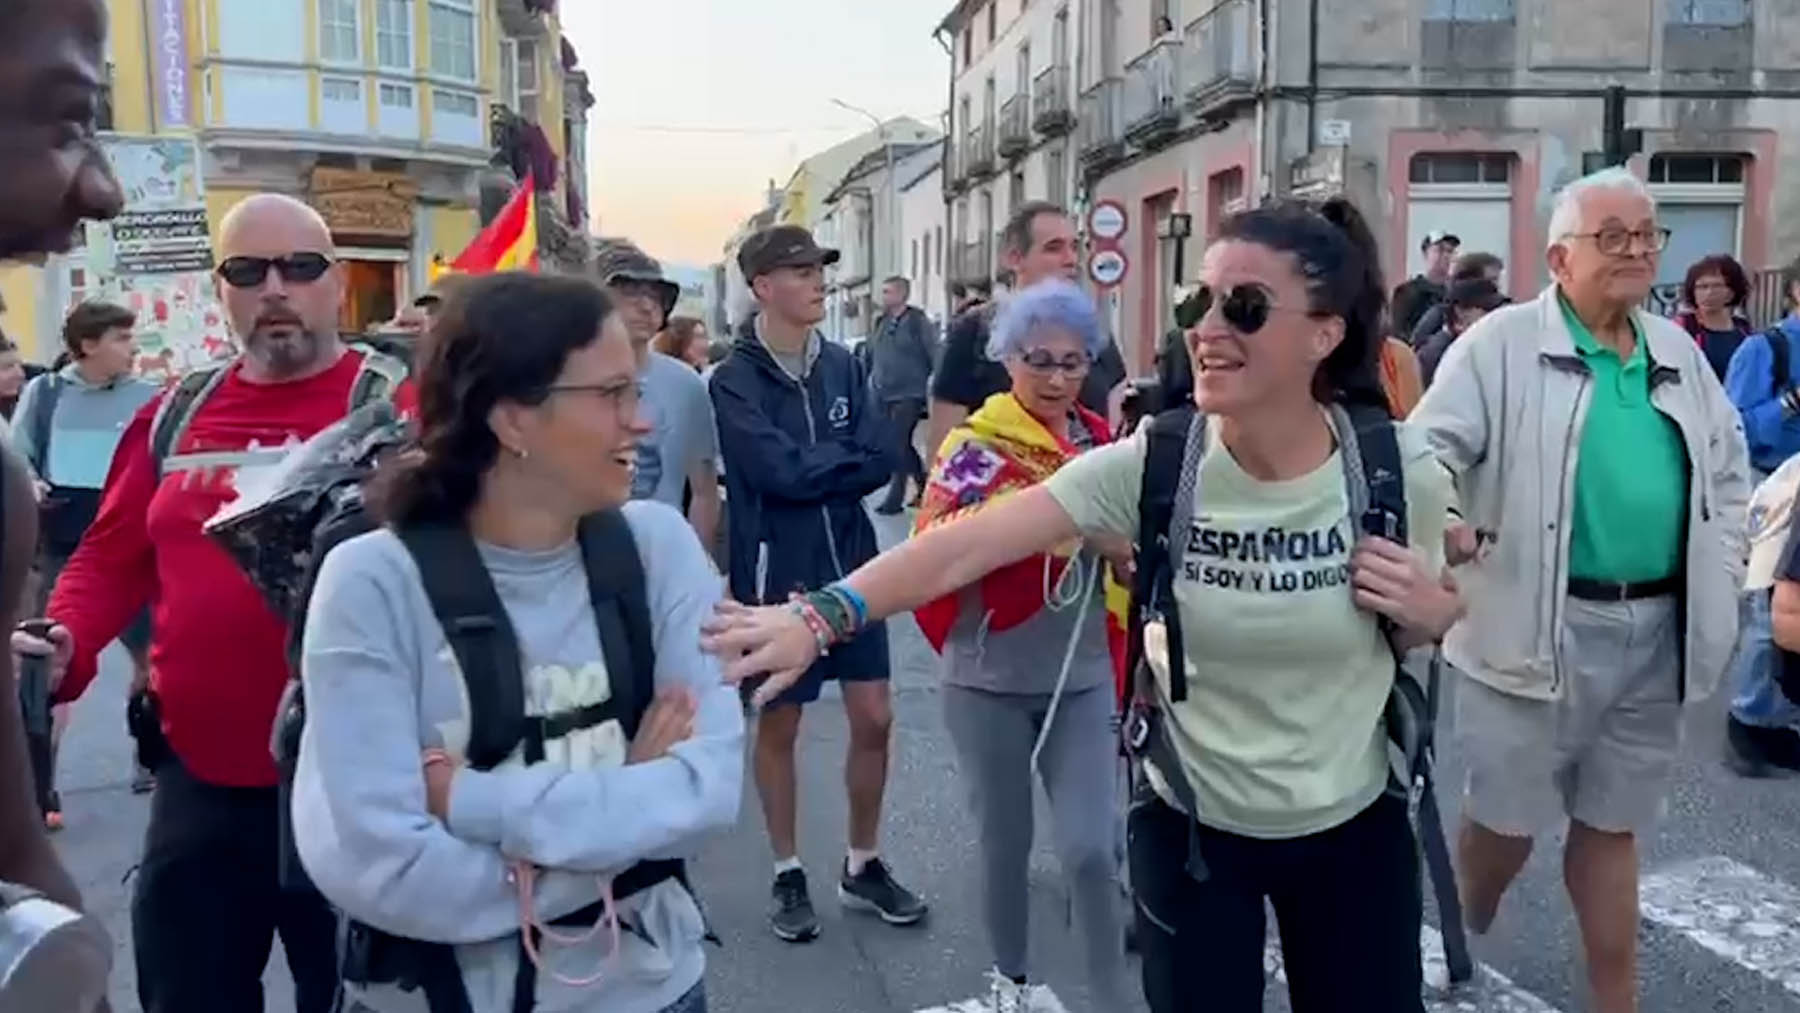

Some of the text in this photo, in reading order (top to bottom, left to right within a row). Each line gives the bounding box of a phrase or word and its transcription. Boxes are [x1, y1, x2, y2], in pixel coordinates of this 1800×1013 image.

[1188, 526, 1346, 562] ESPAÑOLA
[1203, 566, 1244, 590] SOY
[1250, 571, 1264, 592] Y
[1270, 571, 1297, 592] LO
